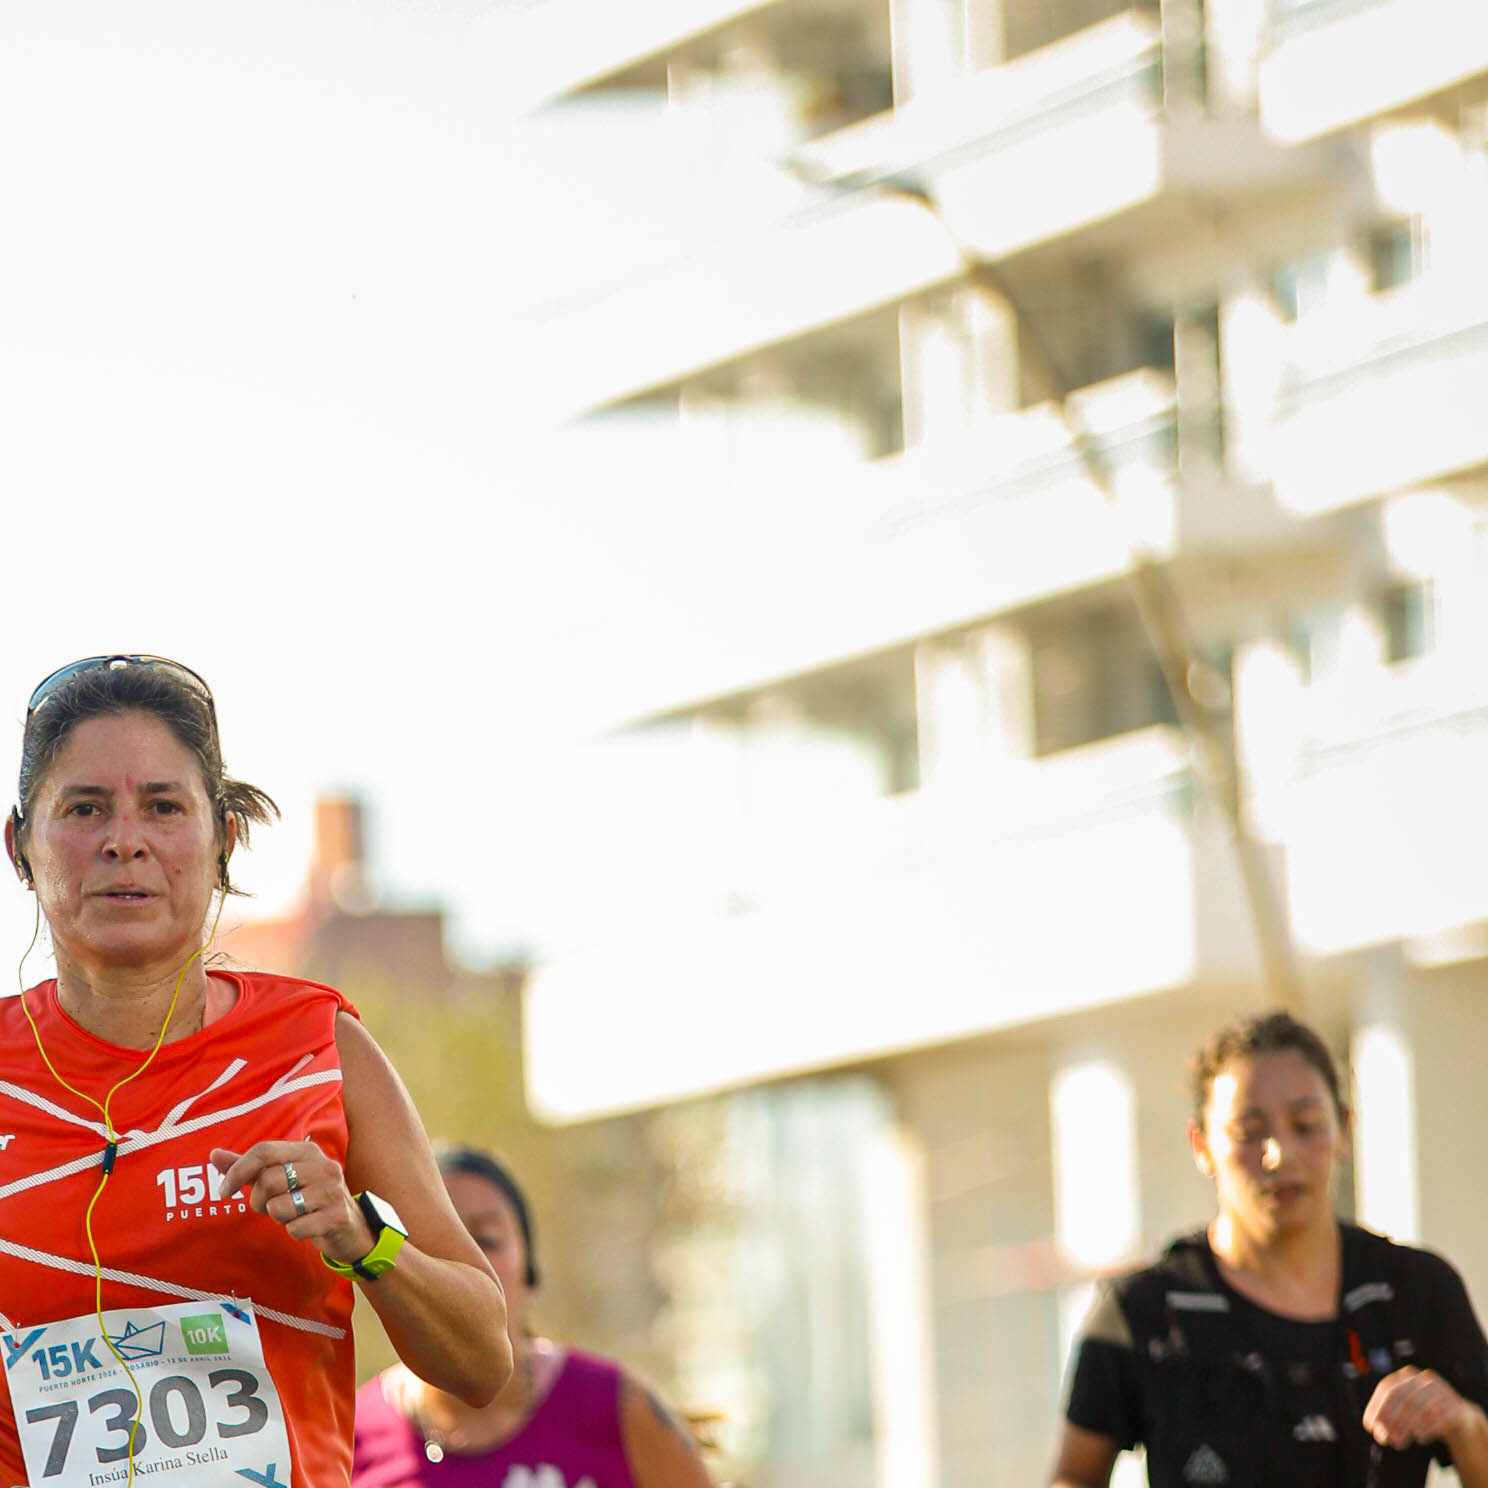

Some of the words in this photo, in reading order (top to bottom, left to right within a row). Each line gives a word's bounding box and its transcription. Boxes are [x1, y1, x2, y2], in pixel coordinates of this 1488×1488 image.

[166, 1203, 246, 1222] PUERTO
[186, 1325, 223, 1345] 10K
[32, 1337, 104, 1381] 15K
[39, 1381, 69, 1393] PUERTO
[71, 1374, 97, 1386] NORTE
[126, 1360, 159, 1371] OSARIO
[25, 1368, 269, 1479] 7303
[88, 1467, 129, 1487] Insúa
[132, 1455, 183, 1477] Karina
[185, 1447, 229, 1466] Stella
